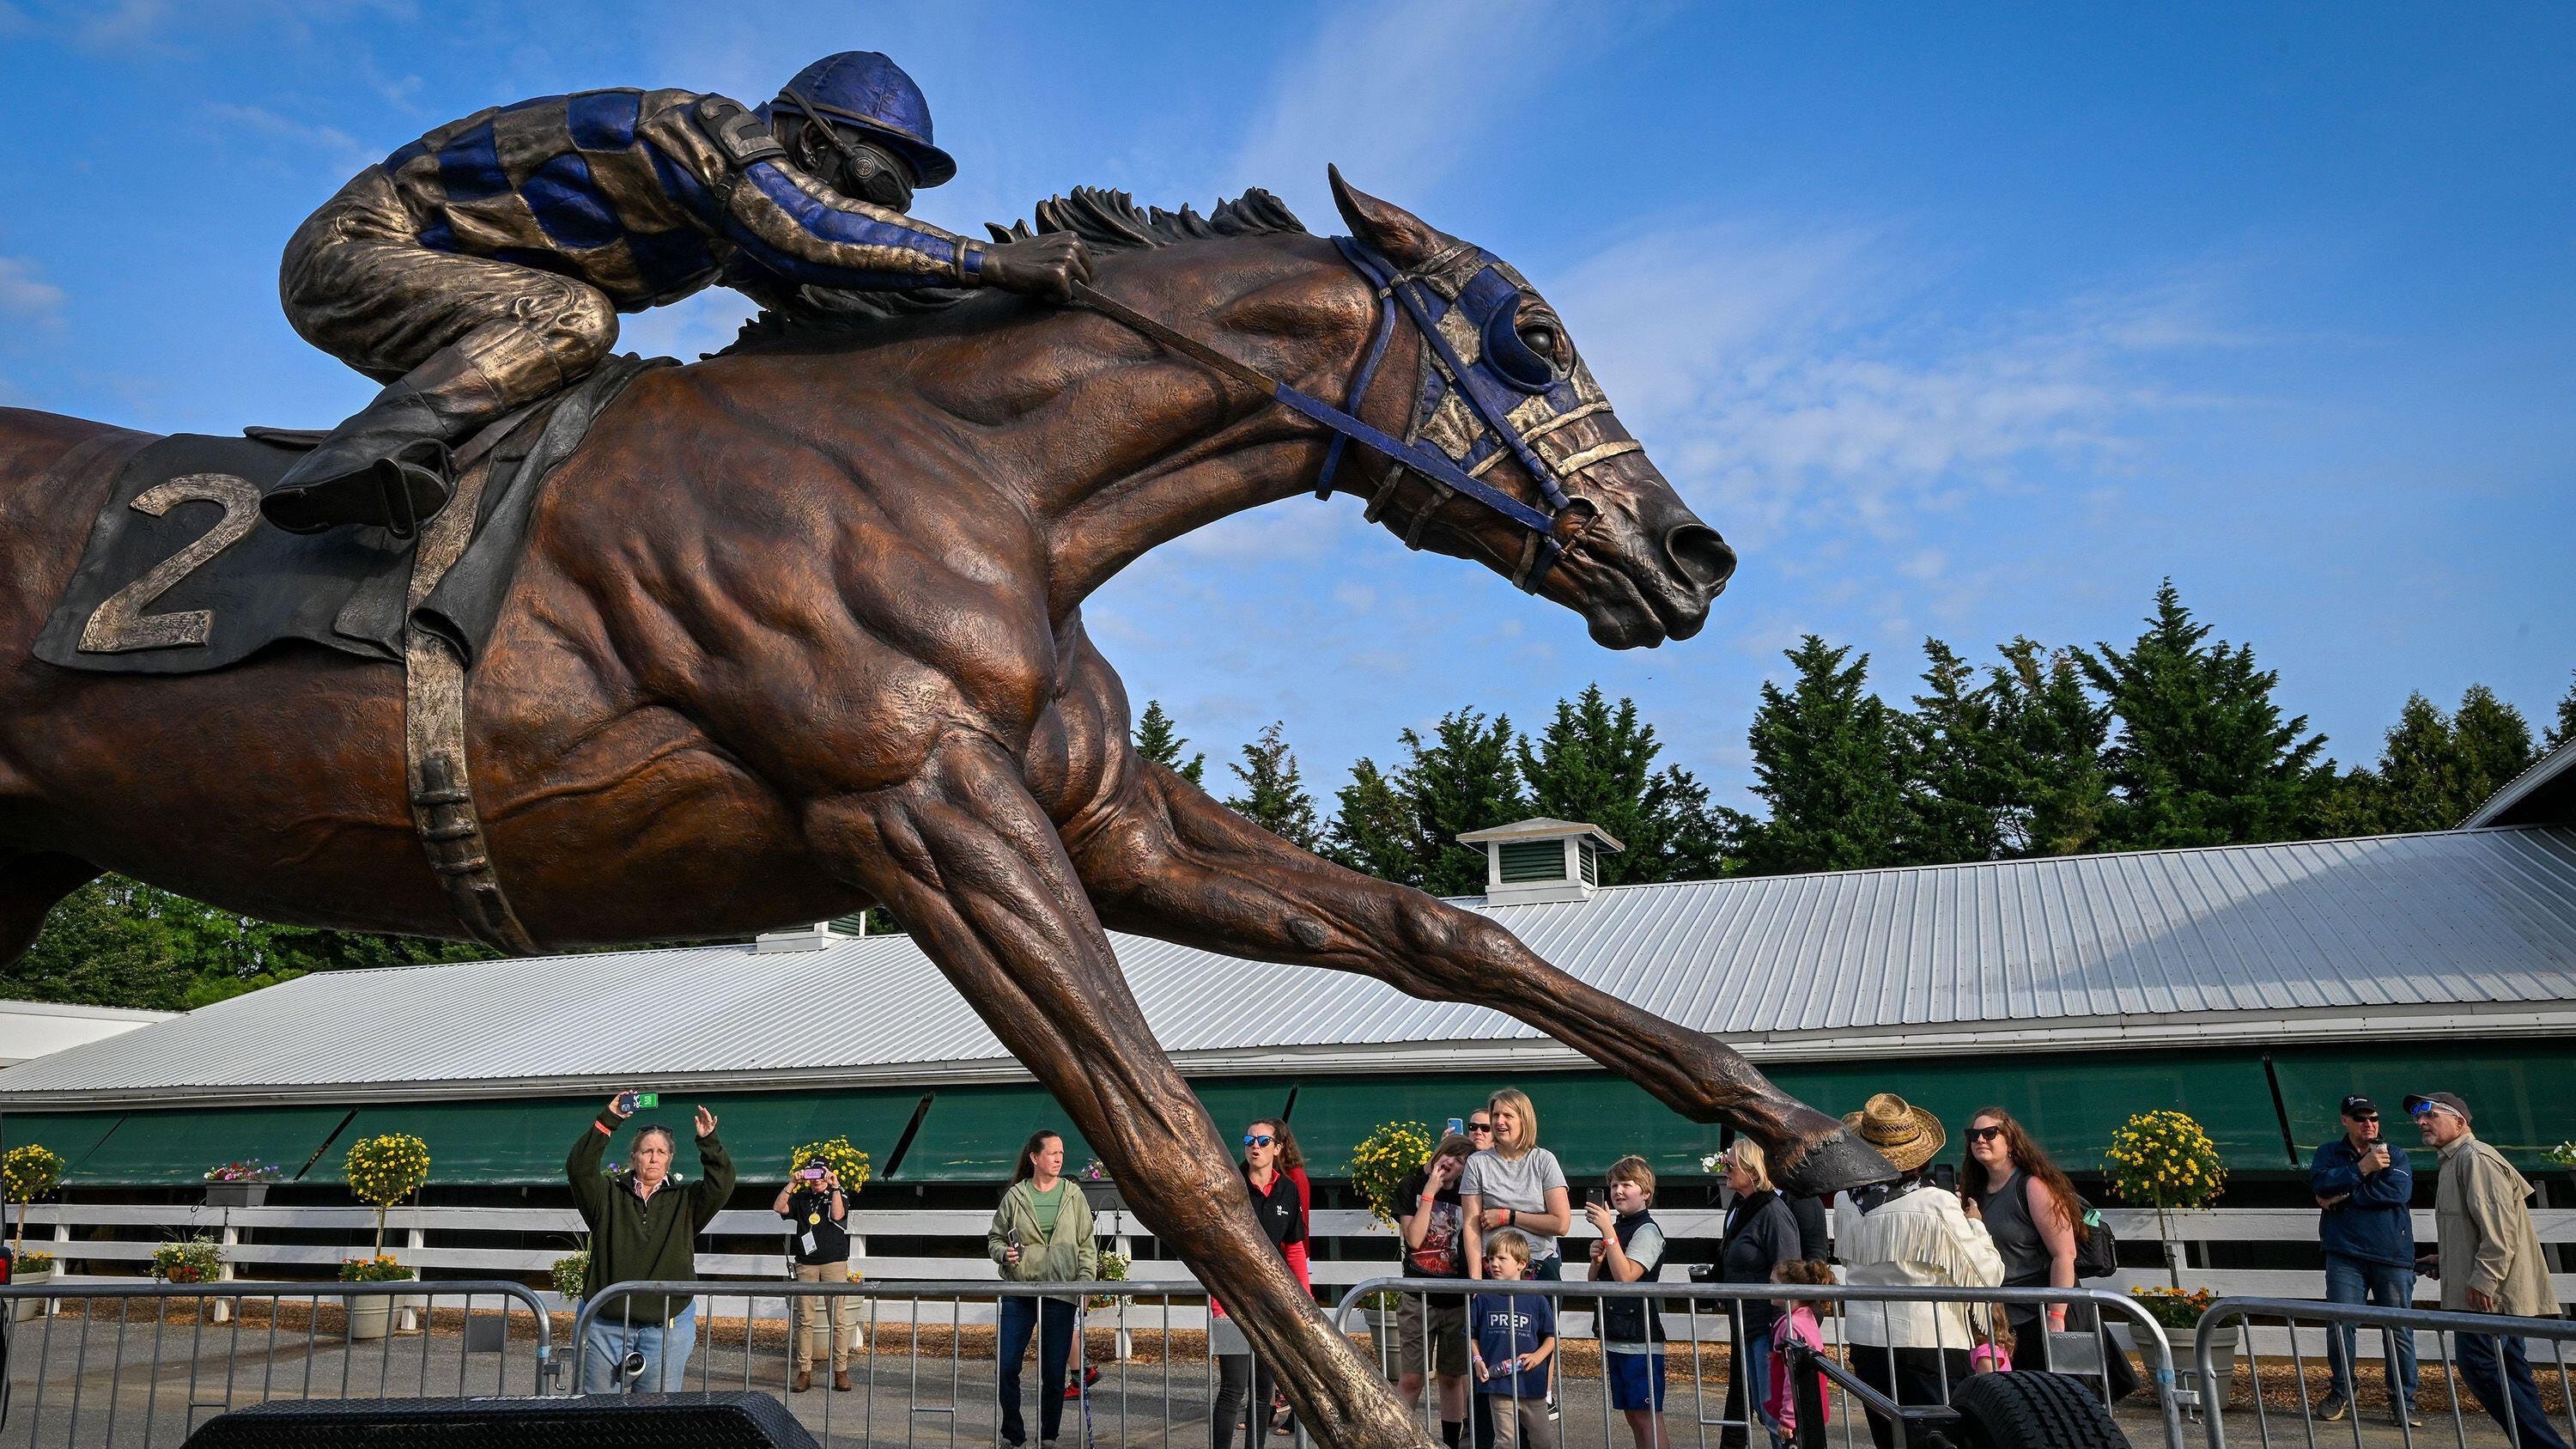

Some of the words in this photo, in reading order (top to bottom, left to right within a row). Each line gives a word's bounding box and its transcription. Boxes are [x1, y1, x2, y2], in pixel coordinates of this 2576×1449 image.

[701, 98, 785, 159] 2
[77, 472, 261, 653] 2
[1490, 1313, 1529, 1328] PREP
